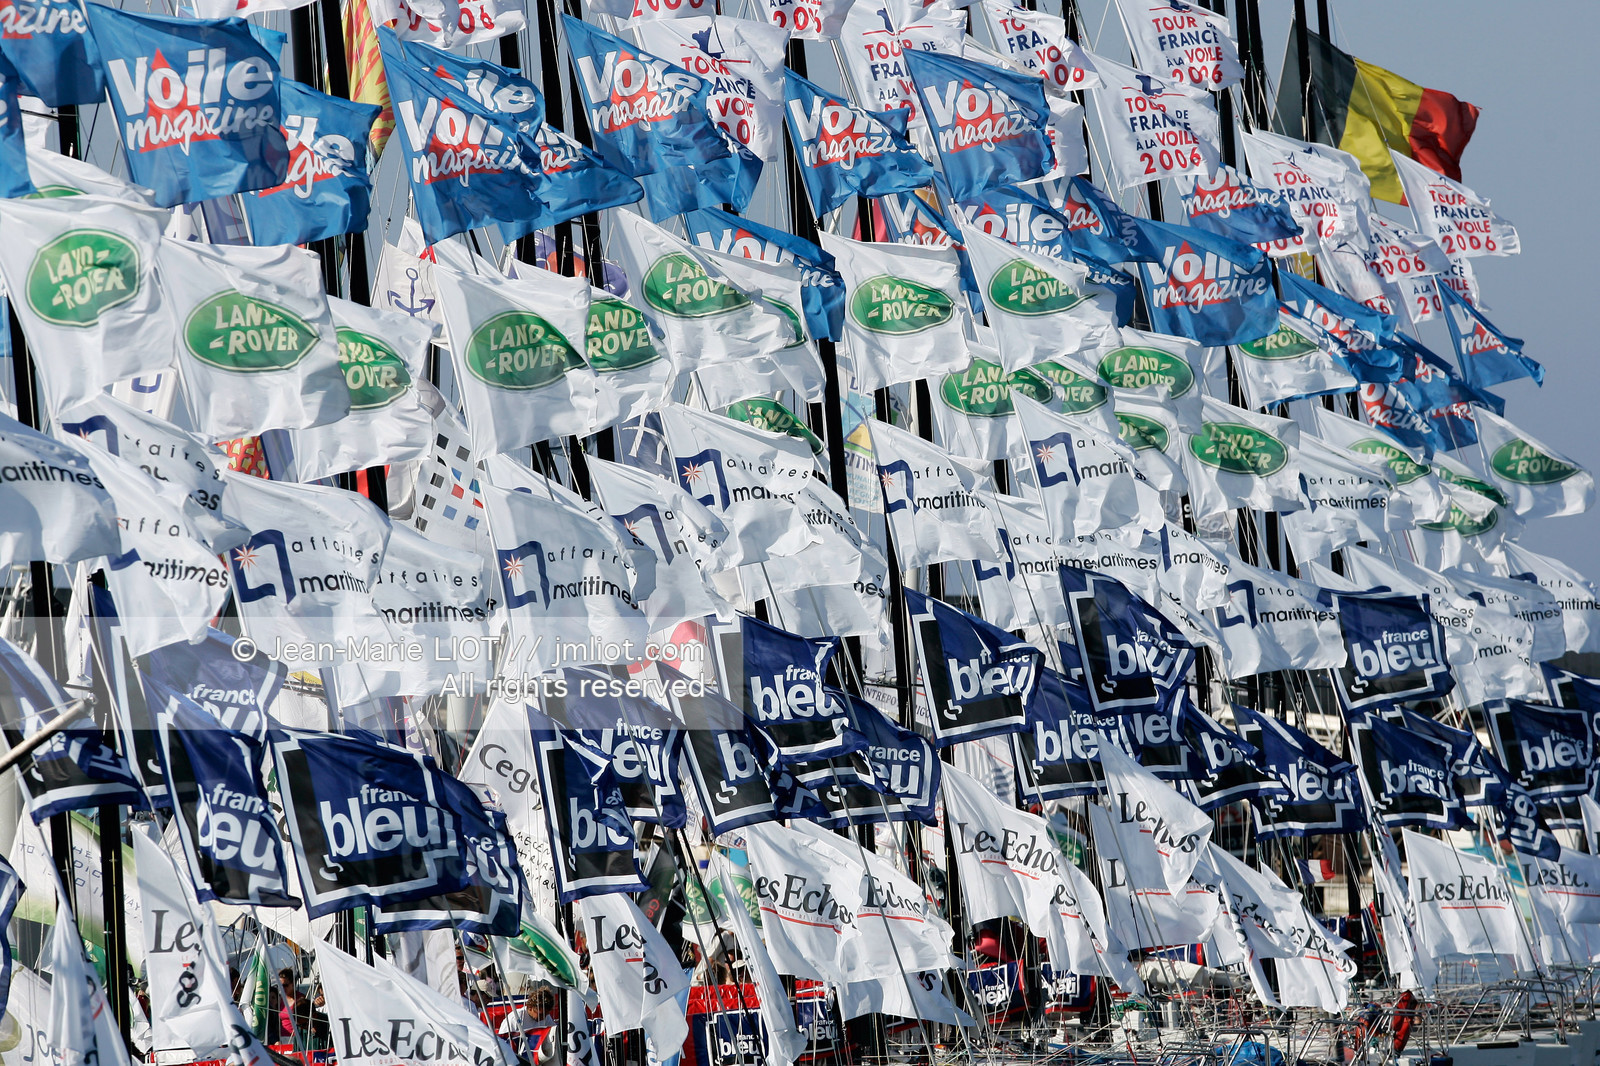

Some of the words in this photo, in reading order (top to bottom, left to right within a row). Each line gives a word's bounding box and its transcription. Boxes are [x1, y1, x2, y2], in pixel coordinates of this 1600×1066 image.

[1152, 16, 1198, 32] TOUR
[922, 41, 937, 51] DE
[1158, 29, 1219, 51] FRANCE
[1184, 46, 1223, 63] VOILE
[108, 47, 273, 116] Voile
[1129, 113, 1192, 132] FRANE
[1175, 110, 1189, 120] DE
[126, 100, 274, 156] magazine
[1156, 130, 1200, 147] VOILE
[1140, 146, 1201, 175] 2006
[1429, 190, 1467, 205] TOUR
[1434, 205, 1488, 219] FRANCE
[1454, 220, 1491, 234] VOILE
[1441, 234, 1496, 254] 2006
[1370, 255, 1426, 278] 2006
[1021, 283, 1073, 305] ROVE
[1152, 274, 1268, 313] magazine
[587, 309, 637, 336] AND
[227, 327, 299, 355] ROVER
[587, 328, 652, 359] ROVE
[0, 461, 105, 490] aritimes
[1098, 552, 1157, 570] aritimes
[1381, 629, 1429, 644] france
[1352, 639, 1436, 678] bleu
[192, 683, 256, 705] france
[868, 745, 921, 763] rance
[320, 797, 442, 857] bleu
